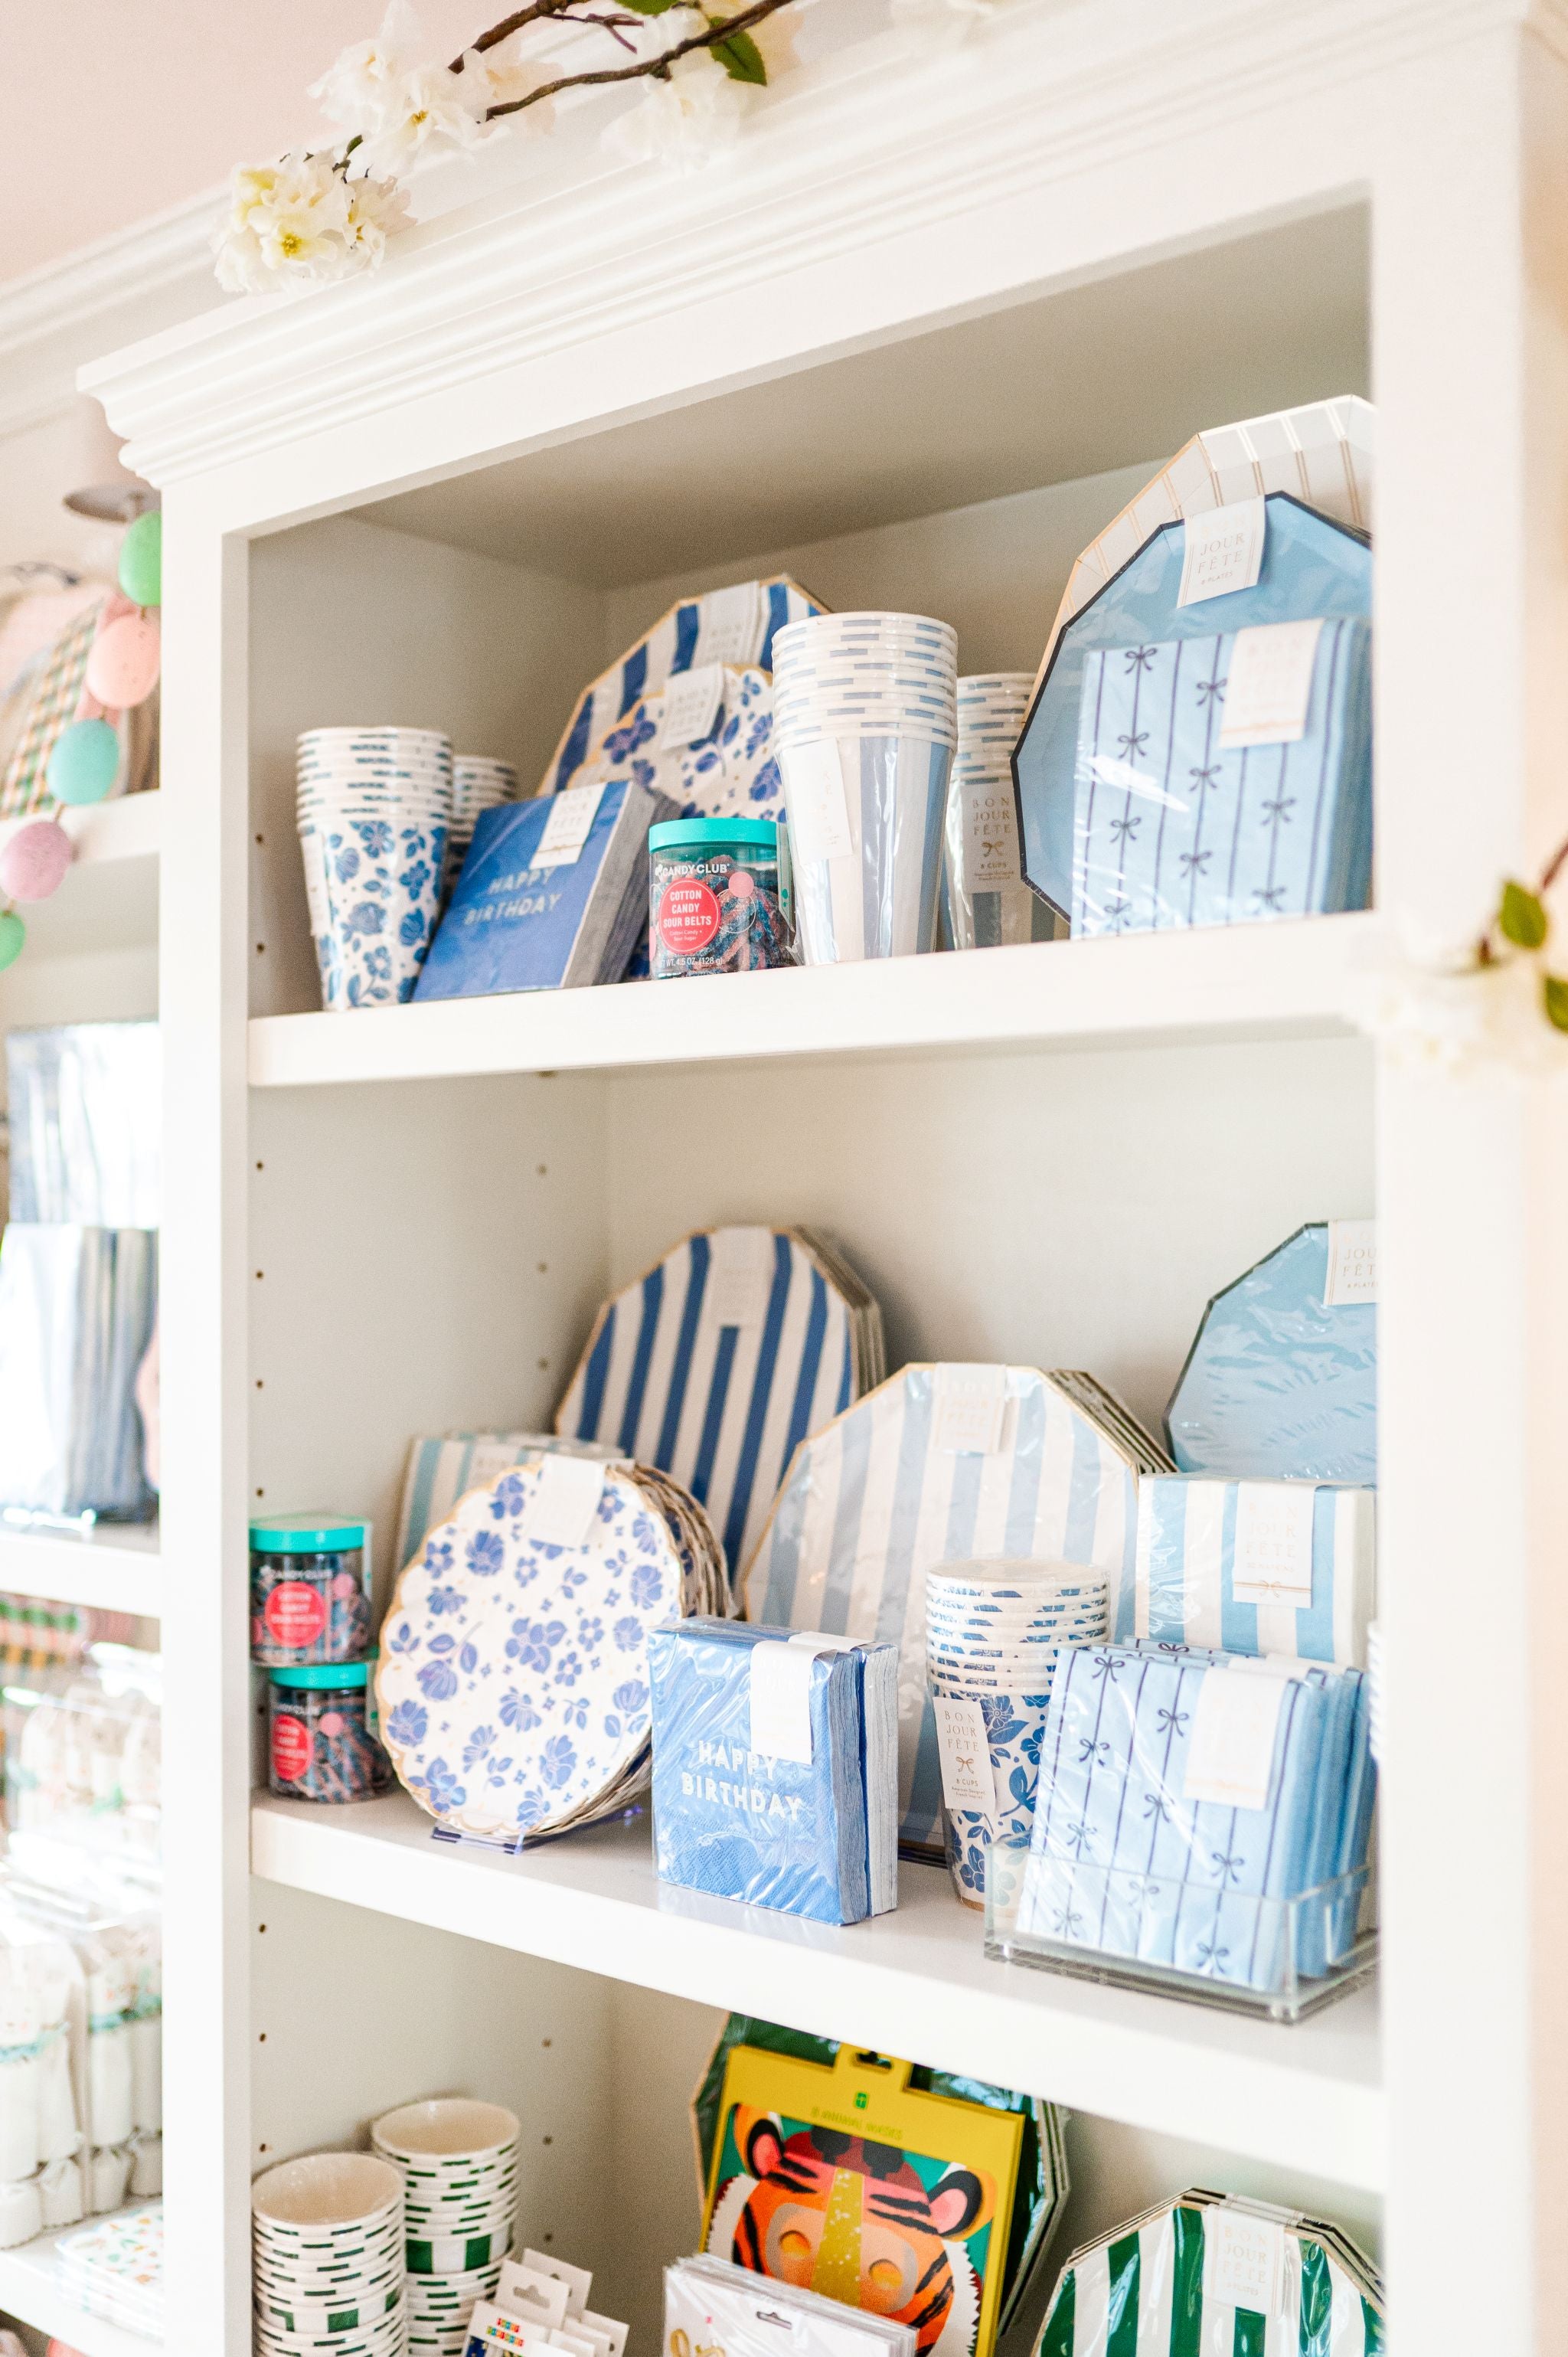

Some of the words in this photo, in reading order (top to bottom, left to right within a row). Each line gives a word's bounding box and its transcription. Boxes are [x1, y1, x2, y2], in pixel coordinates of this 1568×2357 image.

[1200, 531, 1245, 556] JOUR
[1197, 550, 1243, 574] FÊTE
[1207, 571, 1233, 583] PLATES
[972, 797, 1010, 809] BON
[973, 809, 1011, 822] JOUR
[973, 823, 1011, 835] FÊTE
[662, 865, 696, 877] CANDY
[696, 864, 728, 874] CLUB
[487, 866, 558, 894] HAPPY
[669, 890, 702, 902] COTTON
[464, 894, 563, 926] BIRTHDAY
[671, 903, 700, 914] CANDY
[663, 917, 683, 928] SOUR
[684, 915, 712, 926] BELTS
[1344, 1248, 1378, 1260] JOU
[1342, 1263, 1377, 1277] FÊT
[944, 1710, 975, 1724] BON
[946, 1723, 978, 1738] JOUR
[948, 1738, 980, 1753] FÊTE
[697, 1740, 778, 1782] HAPPY
[962, 1778, 978, 1787] CUPS
[681, 1772, 802, 1821] BIRTHDAY
[1225, 2244, 1267, 2264] JOUR
